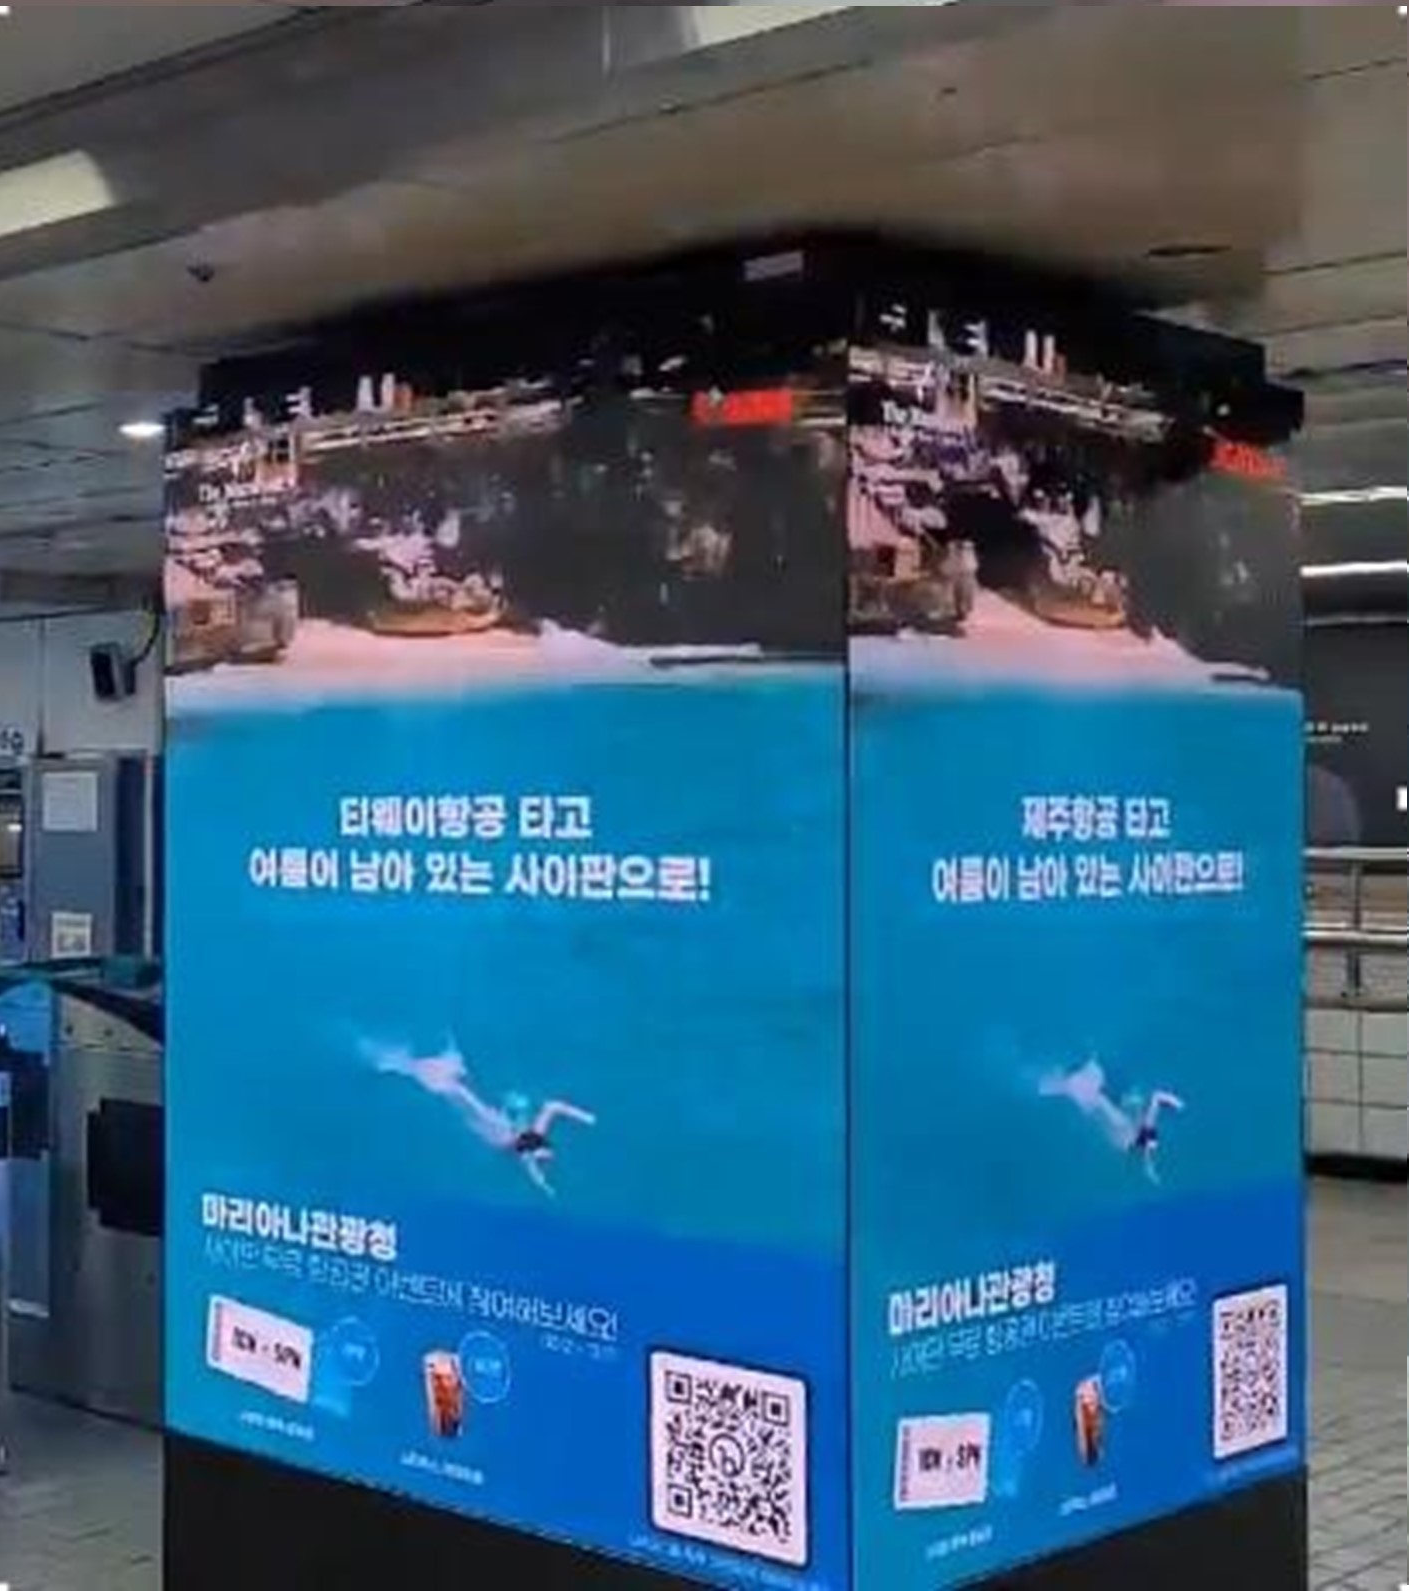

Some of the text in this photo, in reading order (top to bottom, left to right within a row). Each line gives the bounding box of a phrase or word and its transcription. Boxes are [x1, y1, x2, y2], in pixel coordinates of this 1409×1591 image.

[339, 796, 592, 839] 티웨이항공 타고
[1021, 796, 1171, 841] 제주항공 타고
[250, 847, 711, 901] 여름이 남아 있는 사이판으로!
[932, 855, 1010, 902] 여름이
[1017, 853, 1068, 902] 남아
[1074, 853, 1122, 898] 있는
[203, 1193, 397, 1261] 마리아나관광청
[889, 1261, 1056, 1335] 마리아나관광청
